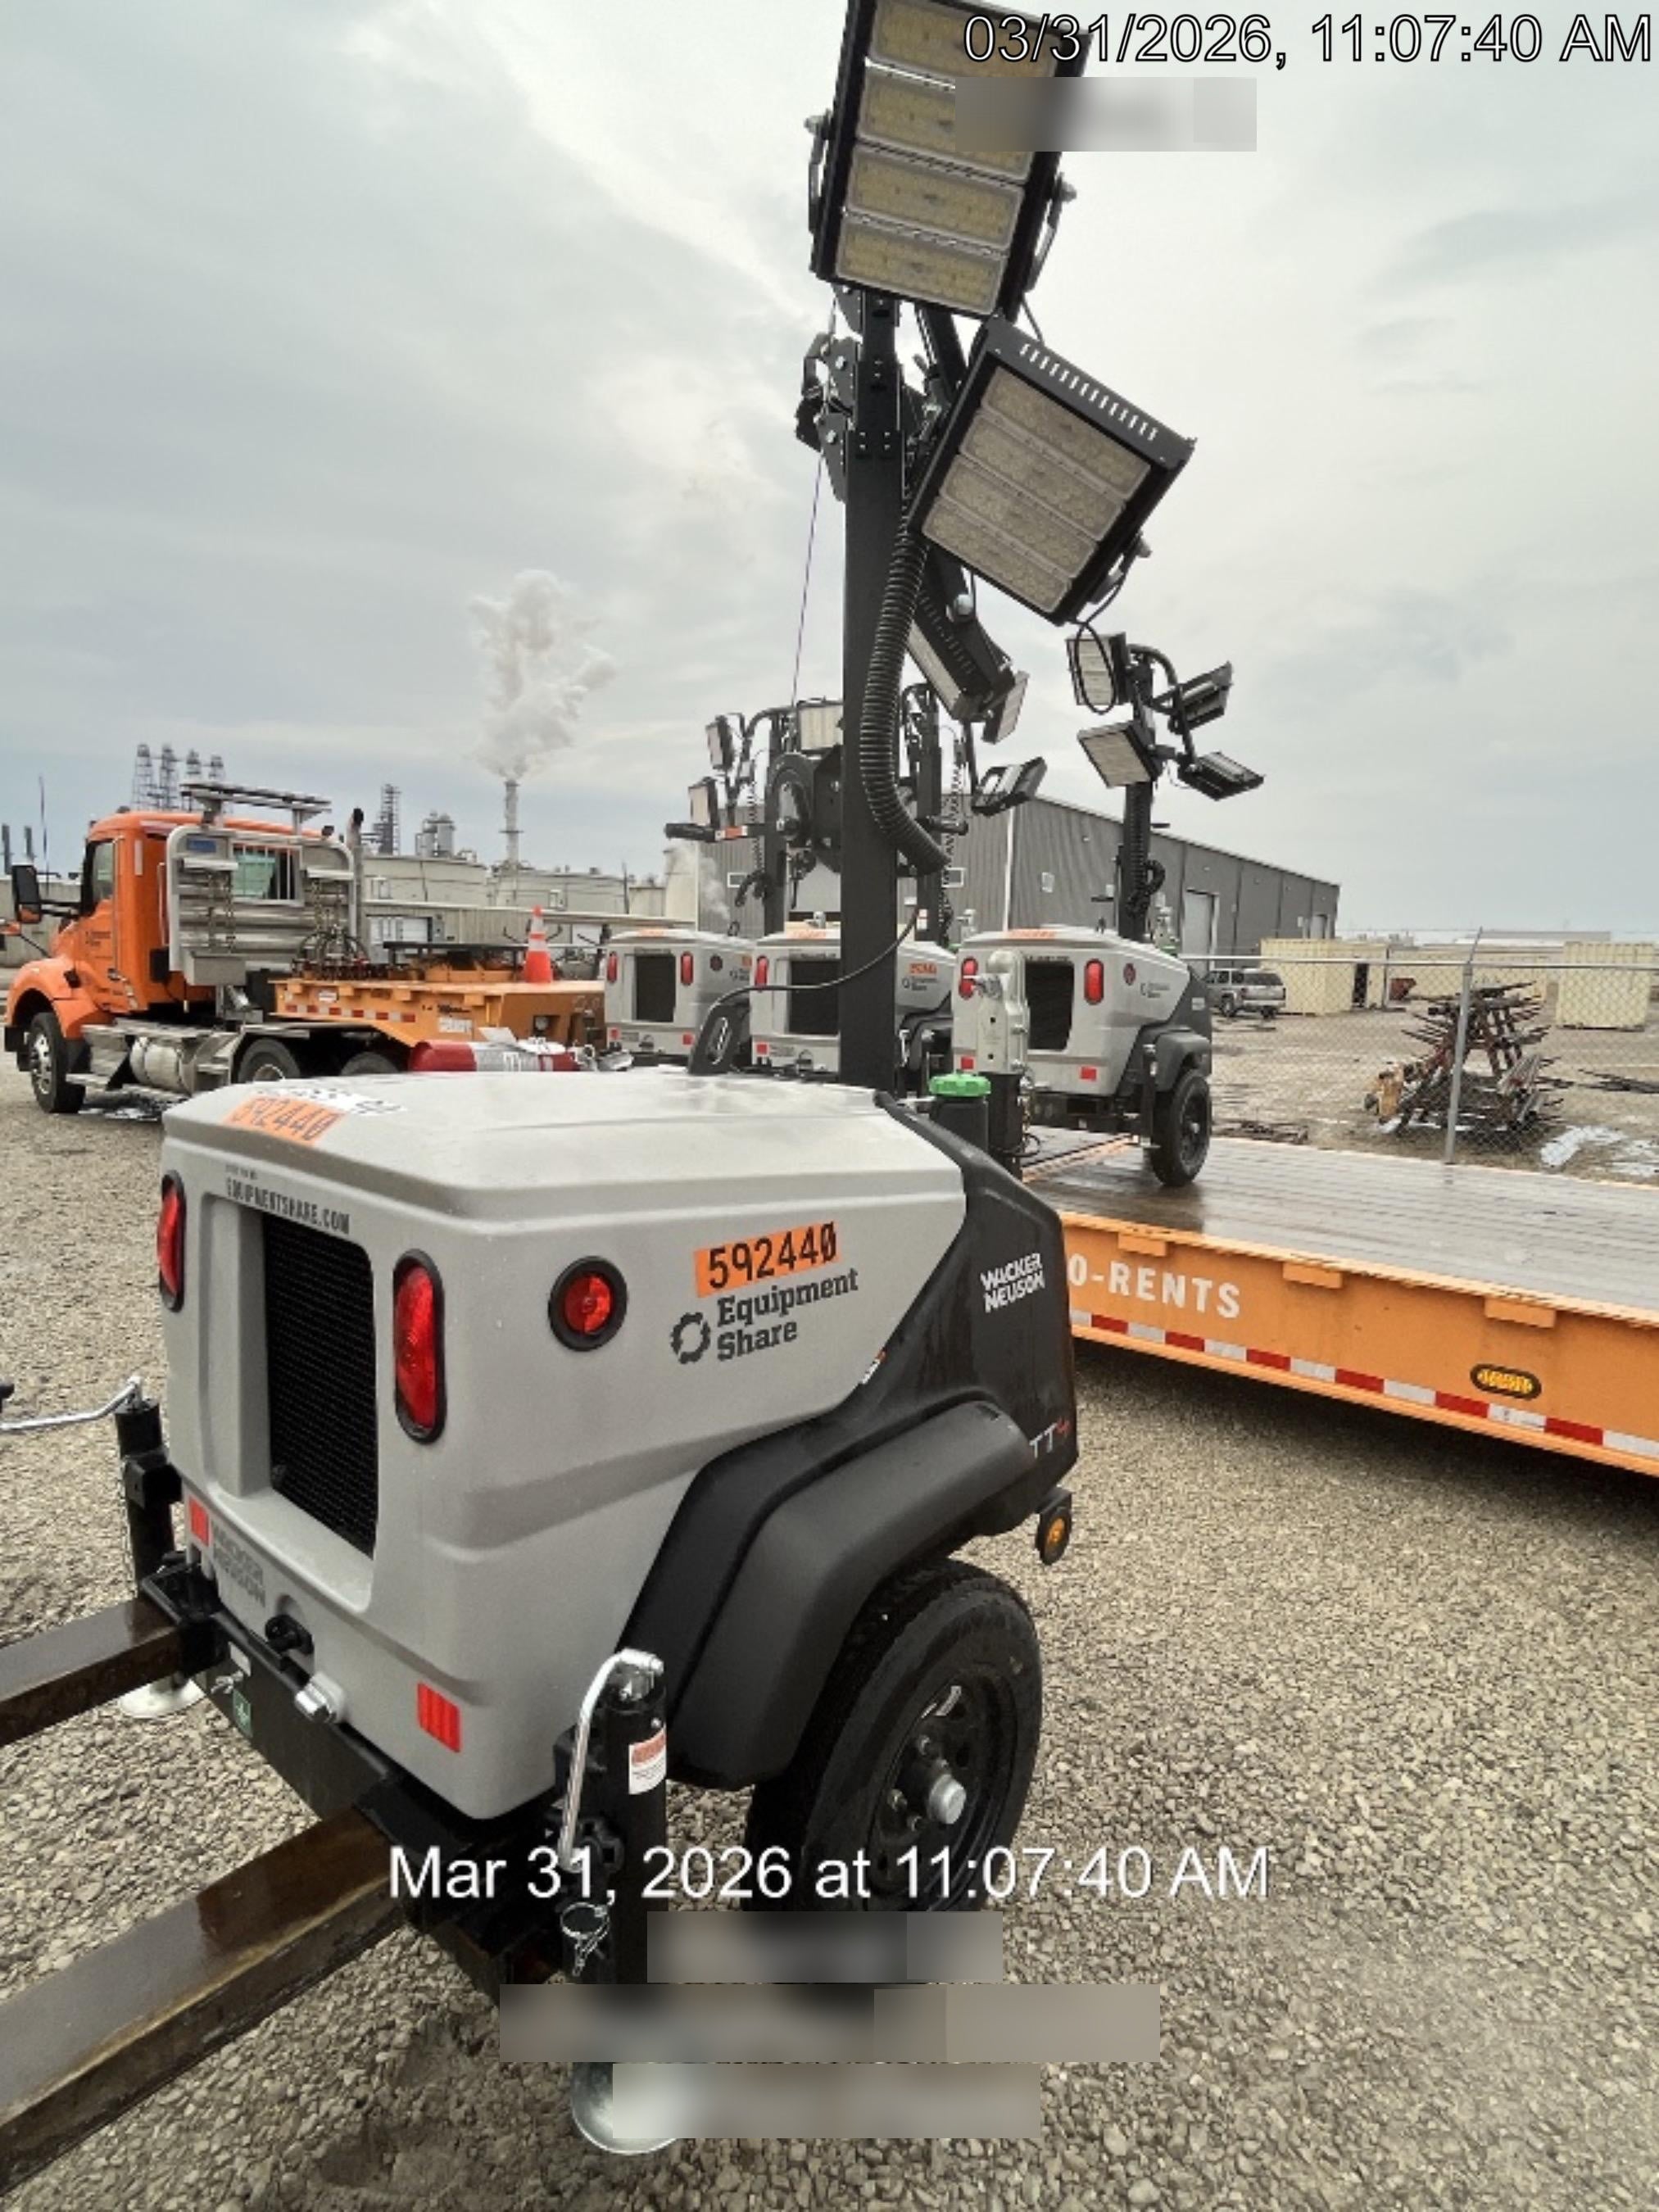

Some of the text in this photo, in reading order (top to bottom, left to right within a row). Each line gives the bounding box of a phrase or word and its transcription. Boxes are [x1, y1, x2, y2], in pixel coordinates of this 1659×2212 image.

[709, 1221, 836, 1290] 592440
[980, 1252, 1043, 1292] WACKER
[717, 1267, 859, 1327] Equipment
[984, 1271, 1045, 1313] NEUSON
[717, 1321, 797, 1362] Share
